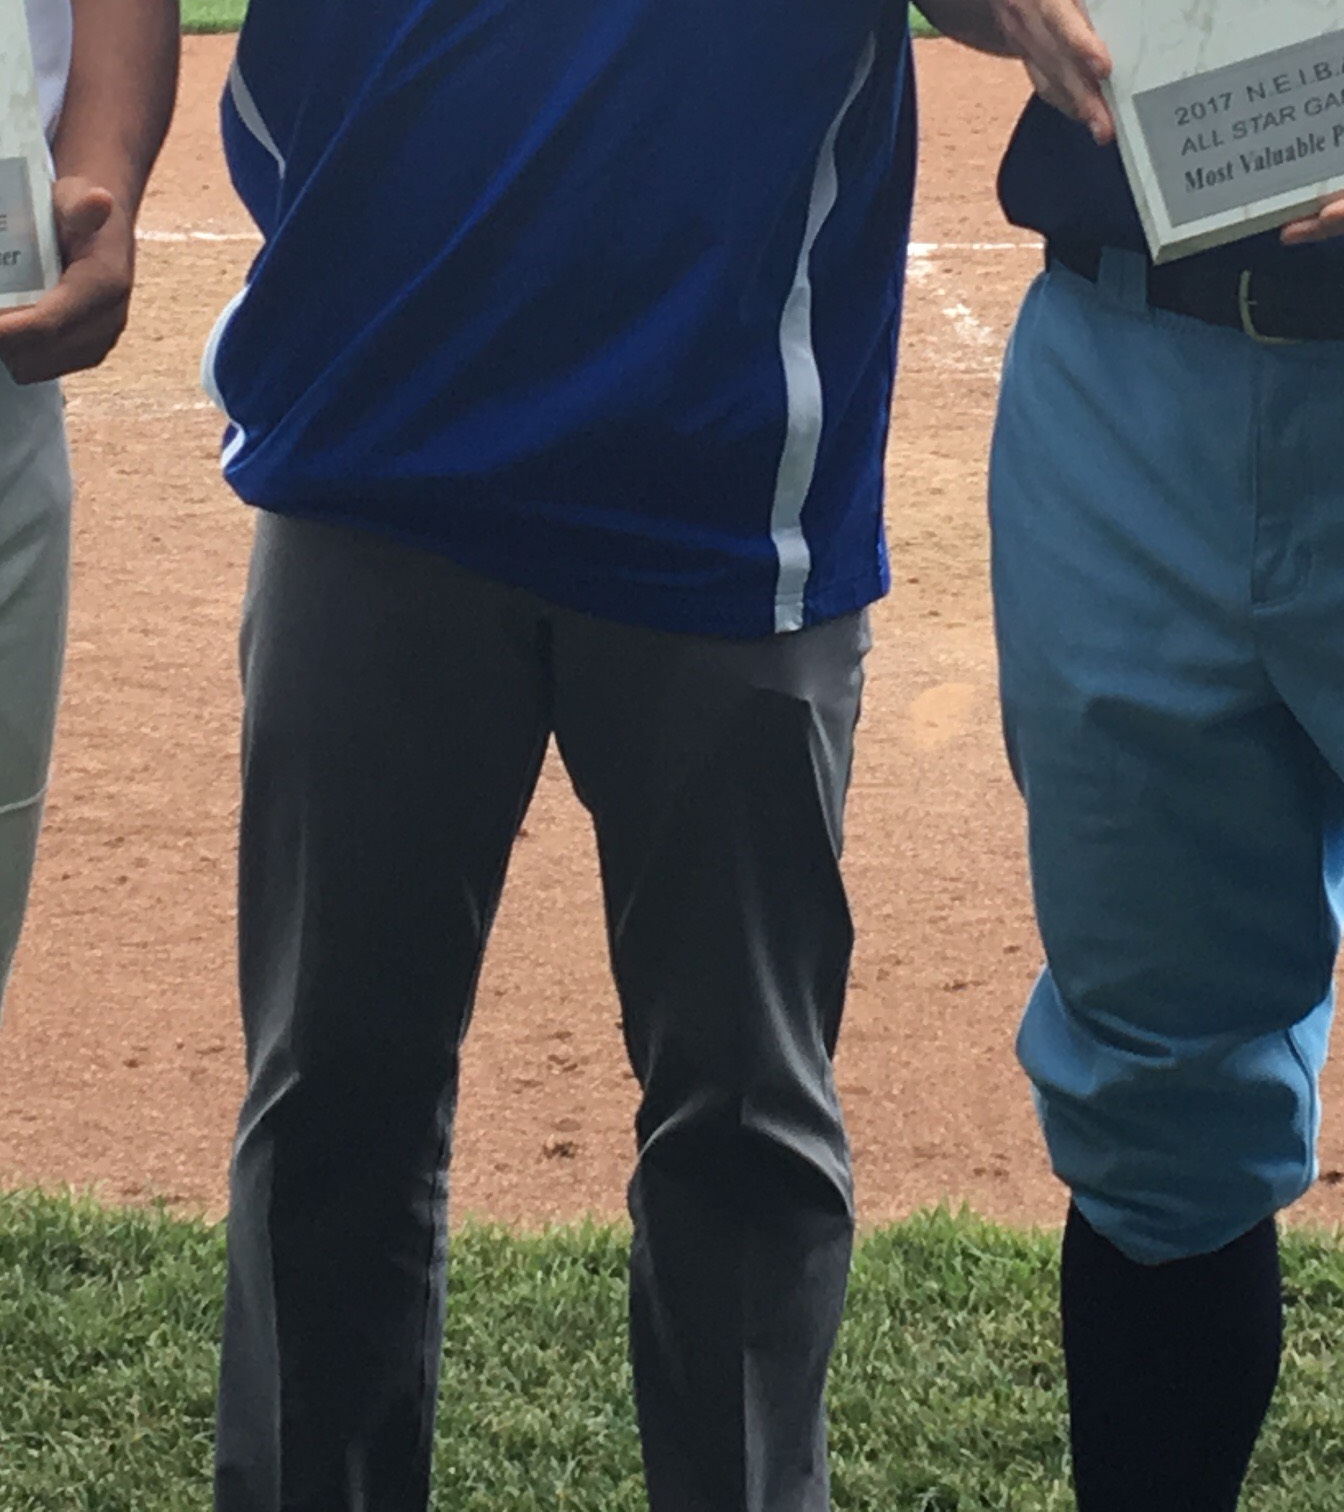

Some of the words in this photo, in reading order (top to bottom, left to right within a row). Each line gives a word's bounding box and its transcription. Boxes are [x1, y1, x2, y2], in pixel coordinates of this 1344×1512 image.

[1174, 91, 1233, 126] 2017
[1180, 130, 1225, 156] ALL
[1231, 105, 1297, 140] STAR
[1184, 161, 1235, 192] Most
[1240, 133, 1326, 175] Valuable
